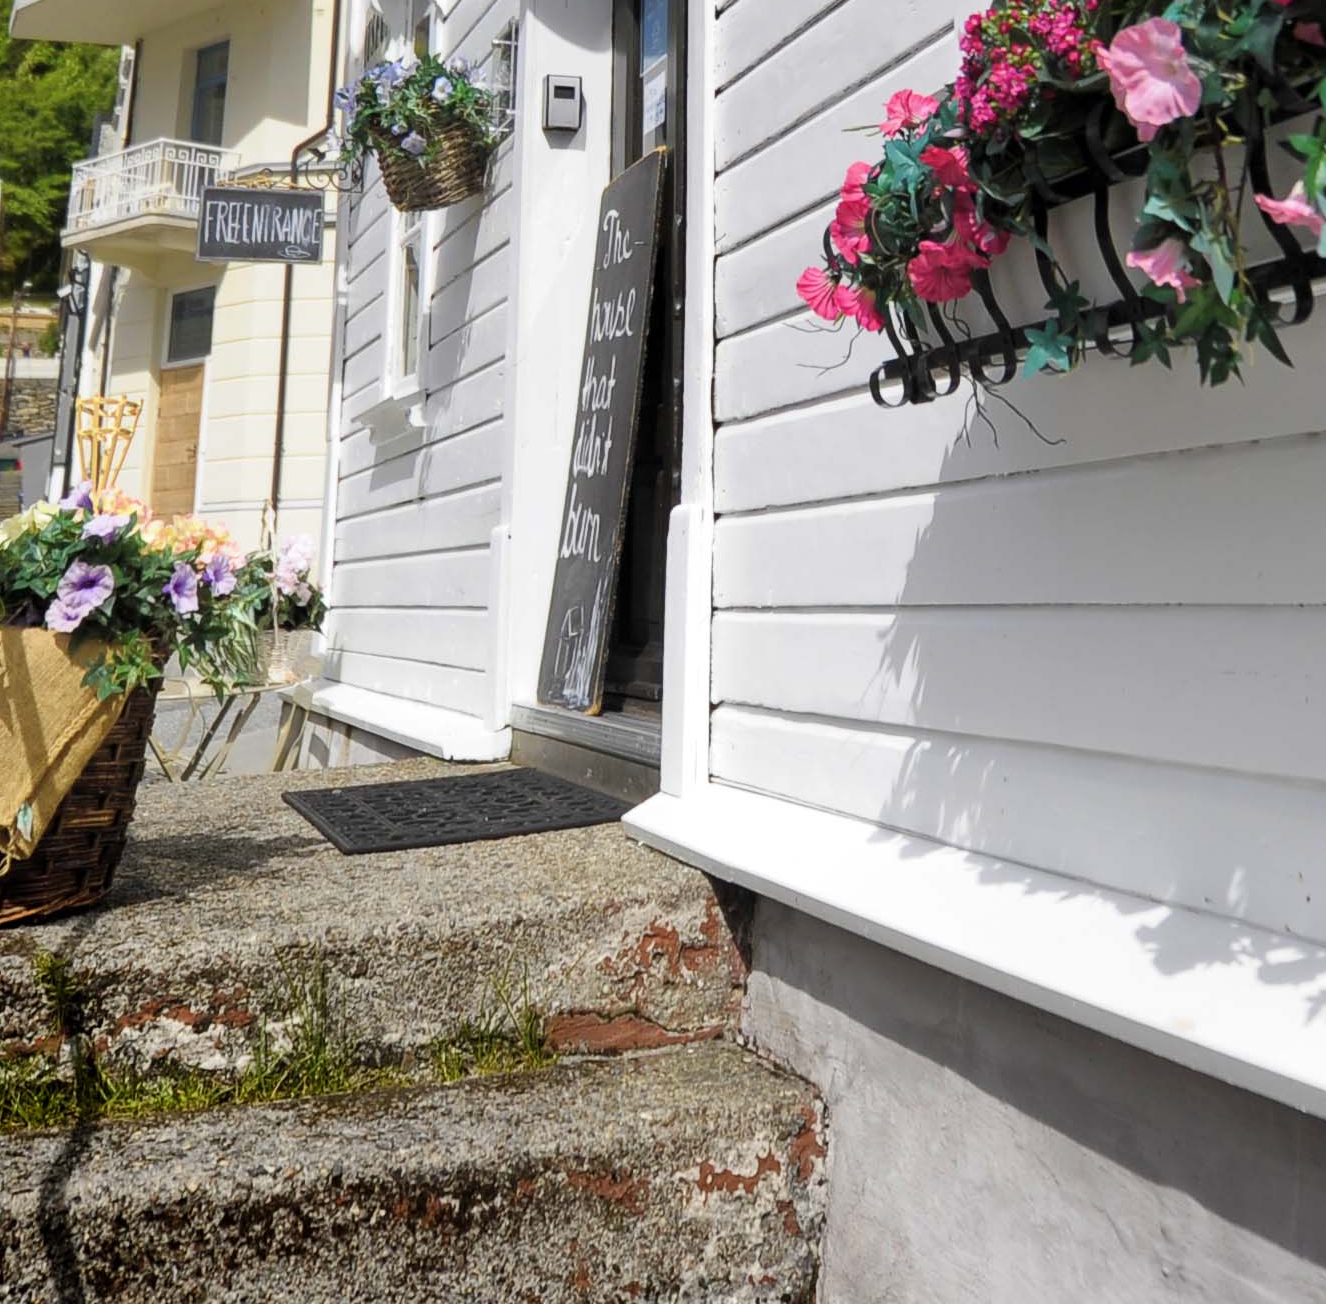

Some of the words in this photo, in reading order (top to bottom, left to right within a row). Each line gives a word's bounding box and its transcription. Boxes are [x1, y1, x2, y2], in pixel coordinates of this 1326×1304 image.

[204, 200, 241, 245] FREE
[242, 203, 322, 246] ENTRANCE
[590, 287, 636, 342] house
[582, 354, 616, 412] that
[560, 483, 601, 563] burn
